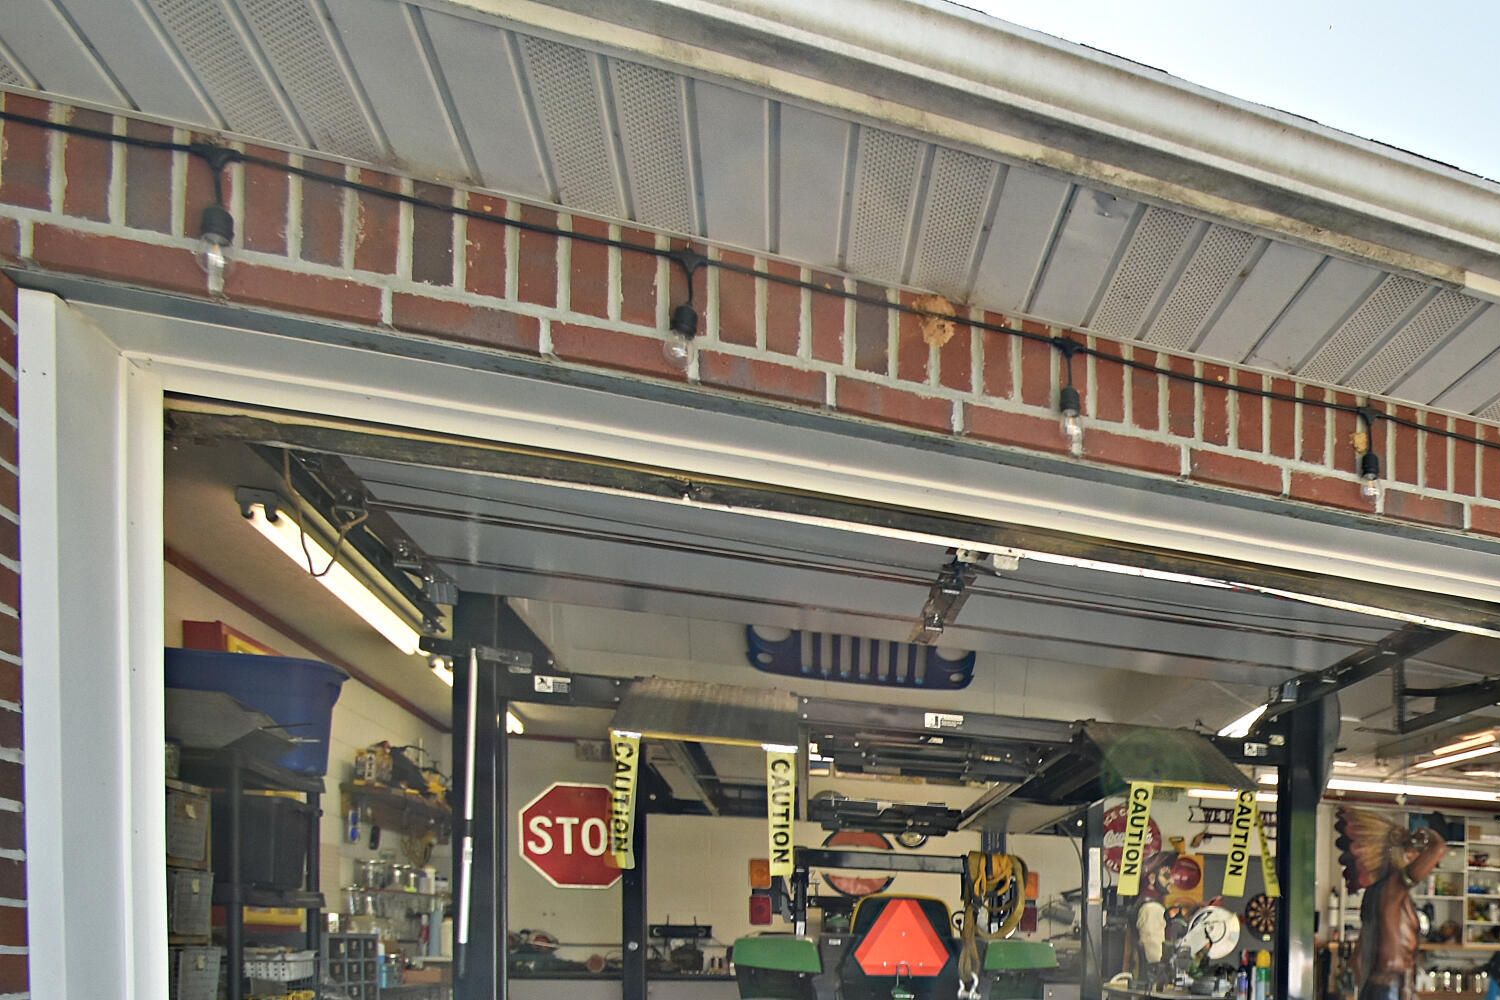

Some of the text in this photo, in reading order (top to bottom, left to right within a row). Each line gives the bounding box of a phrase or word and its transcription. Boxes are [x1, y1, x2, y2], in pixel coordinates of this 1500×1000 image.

[771, 759, 790, 863] CAUTION
[1122, 787, 1149, 876] CAUTION
[1228, 790, 1253, 877] CAUTION
